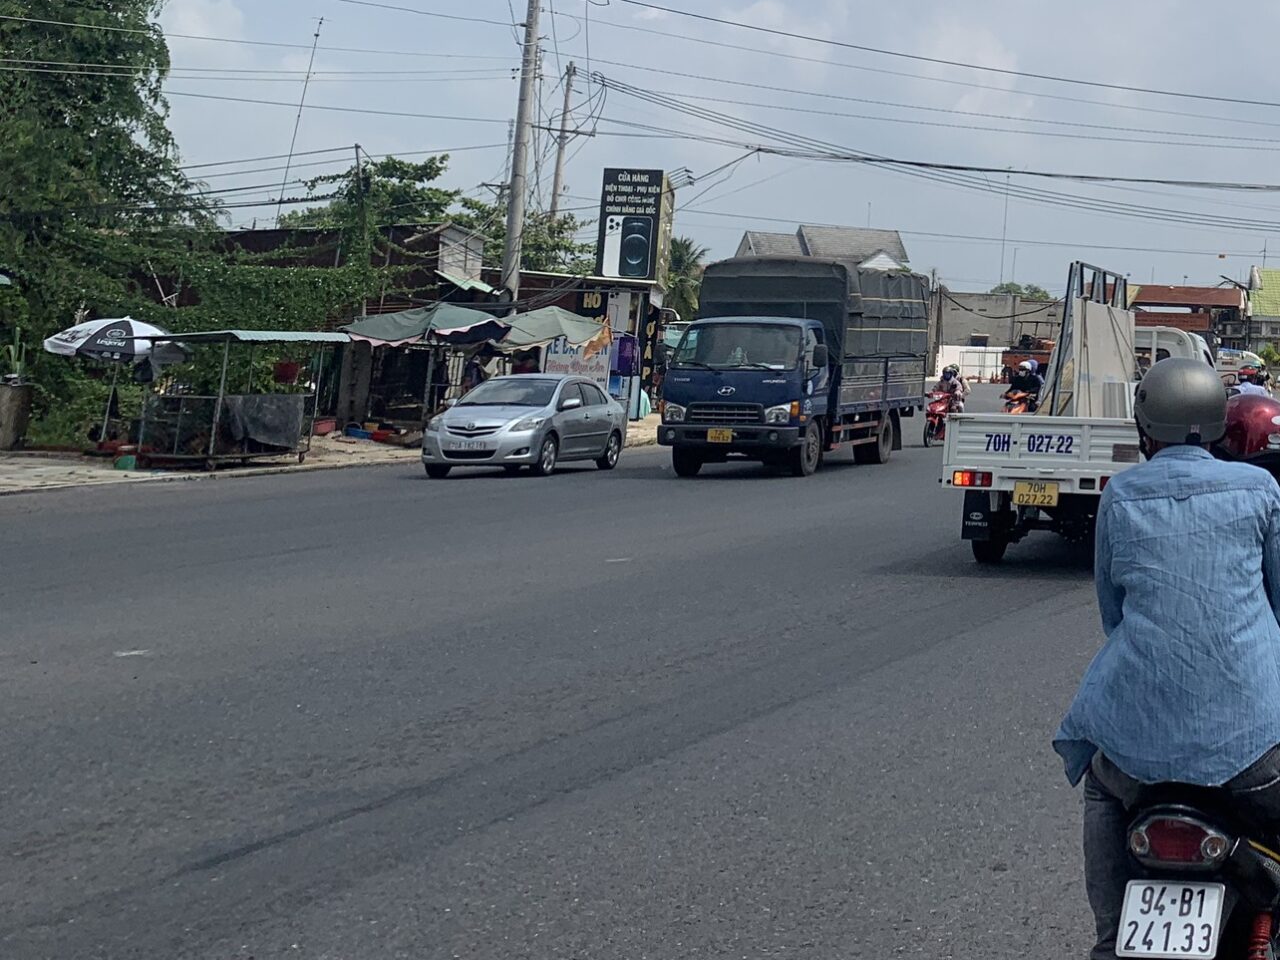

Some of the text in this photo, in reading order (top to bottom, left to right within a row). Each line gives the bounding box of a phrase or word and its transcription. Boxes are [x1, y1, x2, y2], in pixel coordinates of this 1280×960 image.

[618, 171, 649, 182] CỬA HÀNG
[96, 338, 126, 348] Legend
[1027, 482, 1046, 493] 70H
[1018, 493, 1053, 505] 027.22
[1124, 920, 1212, 953] 241.33
